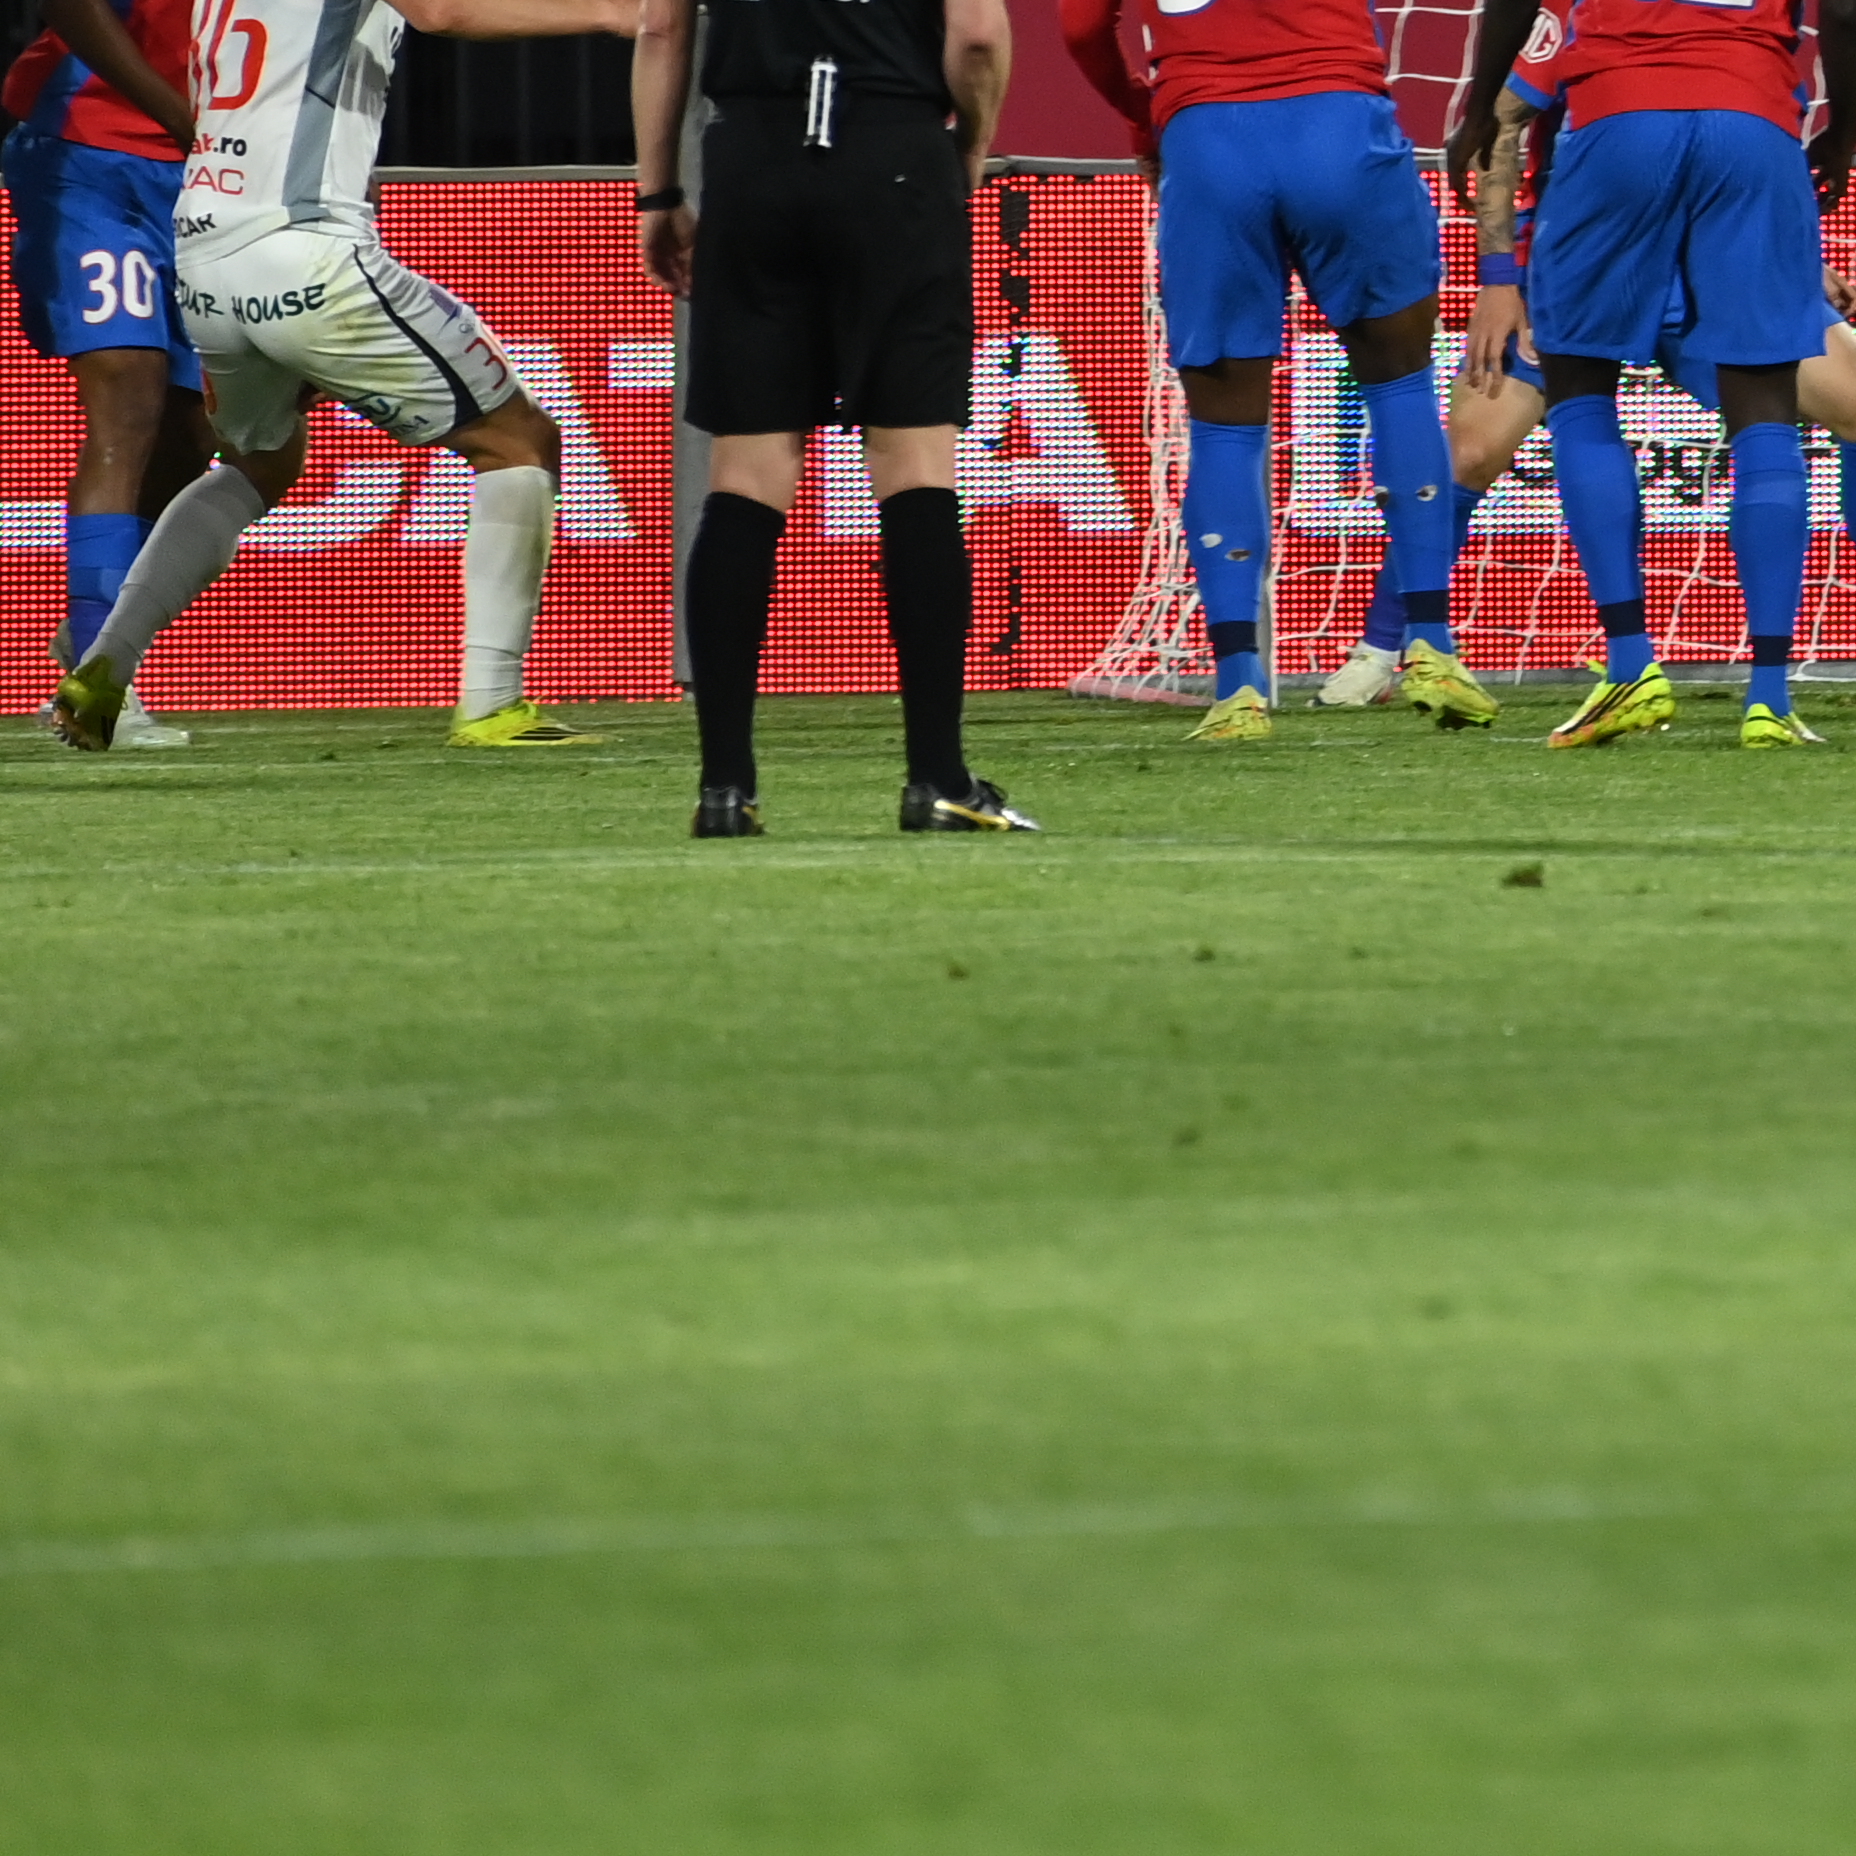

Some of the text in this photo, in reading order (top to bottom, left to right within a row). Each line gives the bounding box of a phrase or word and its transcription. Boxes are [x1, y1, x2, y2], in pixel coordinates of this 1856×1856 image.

[173, 212, 218, 239] CAR
[80, 249, 156, 324] 30
[231, 282, 327, 325] HOUSE
